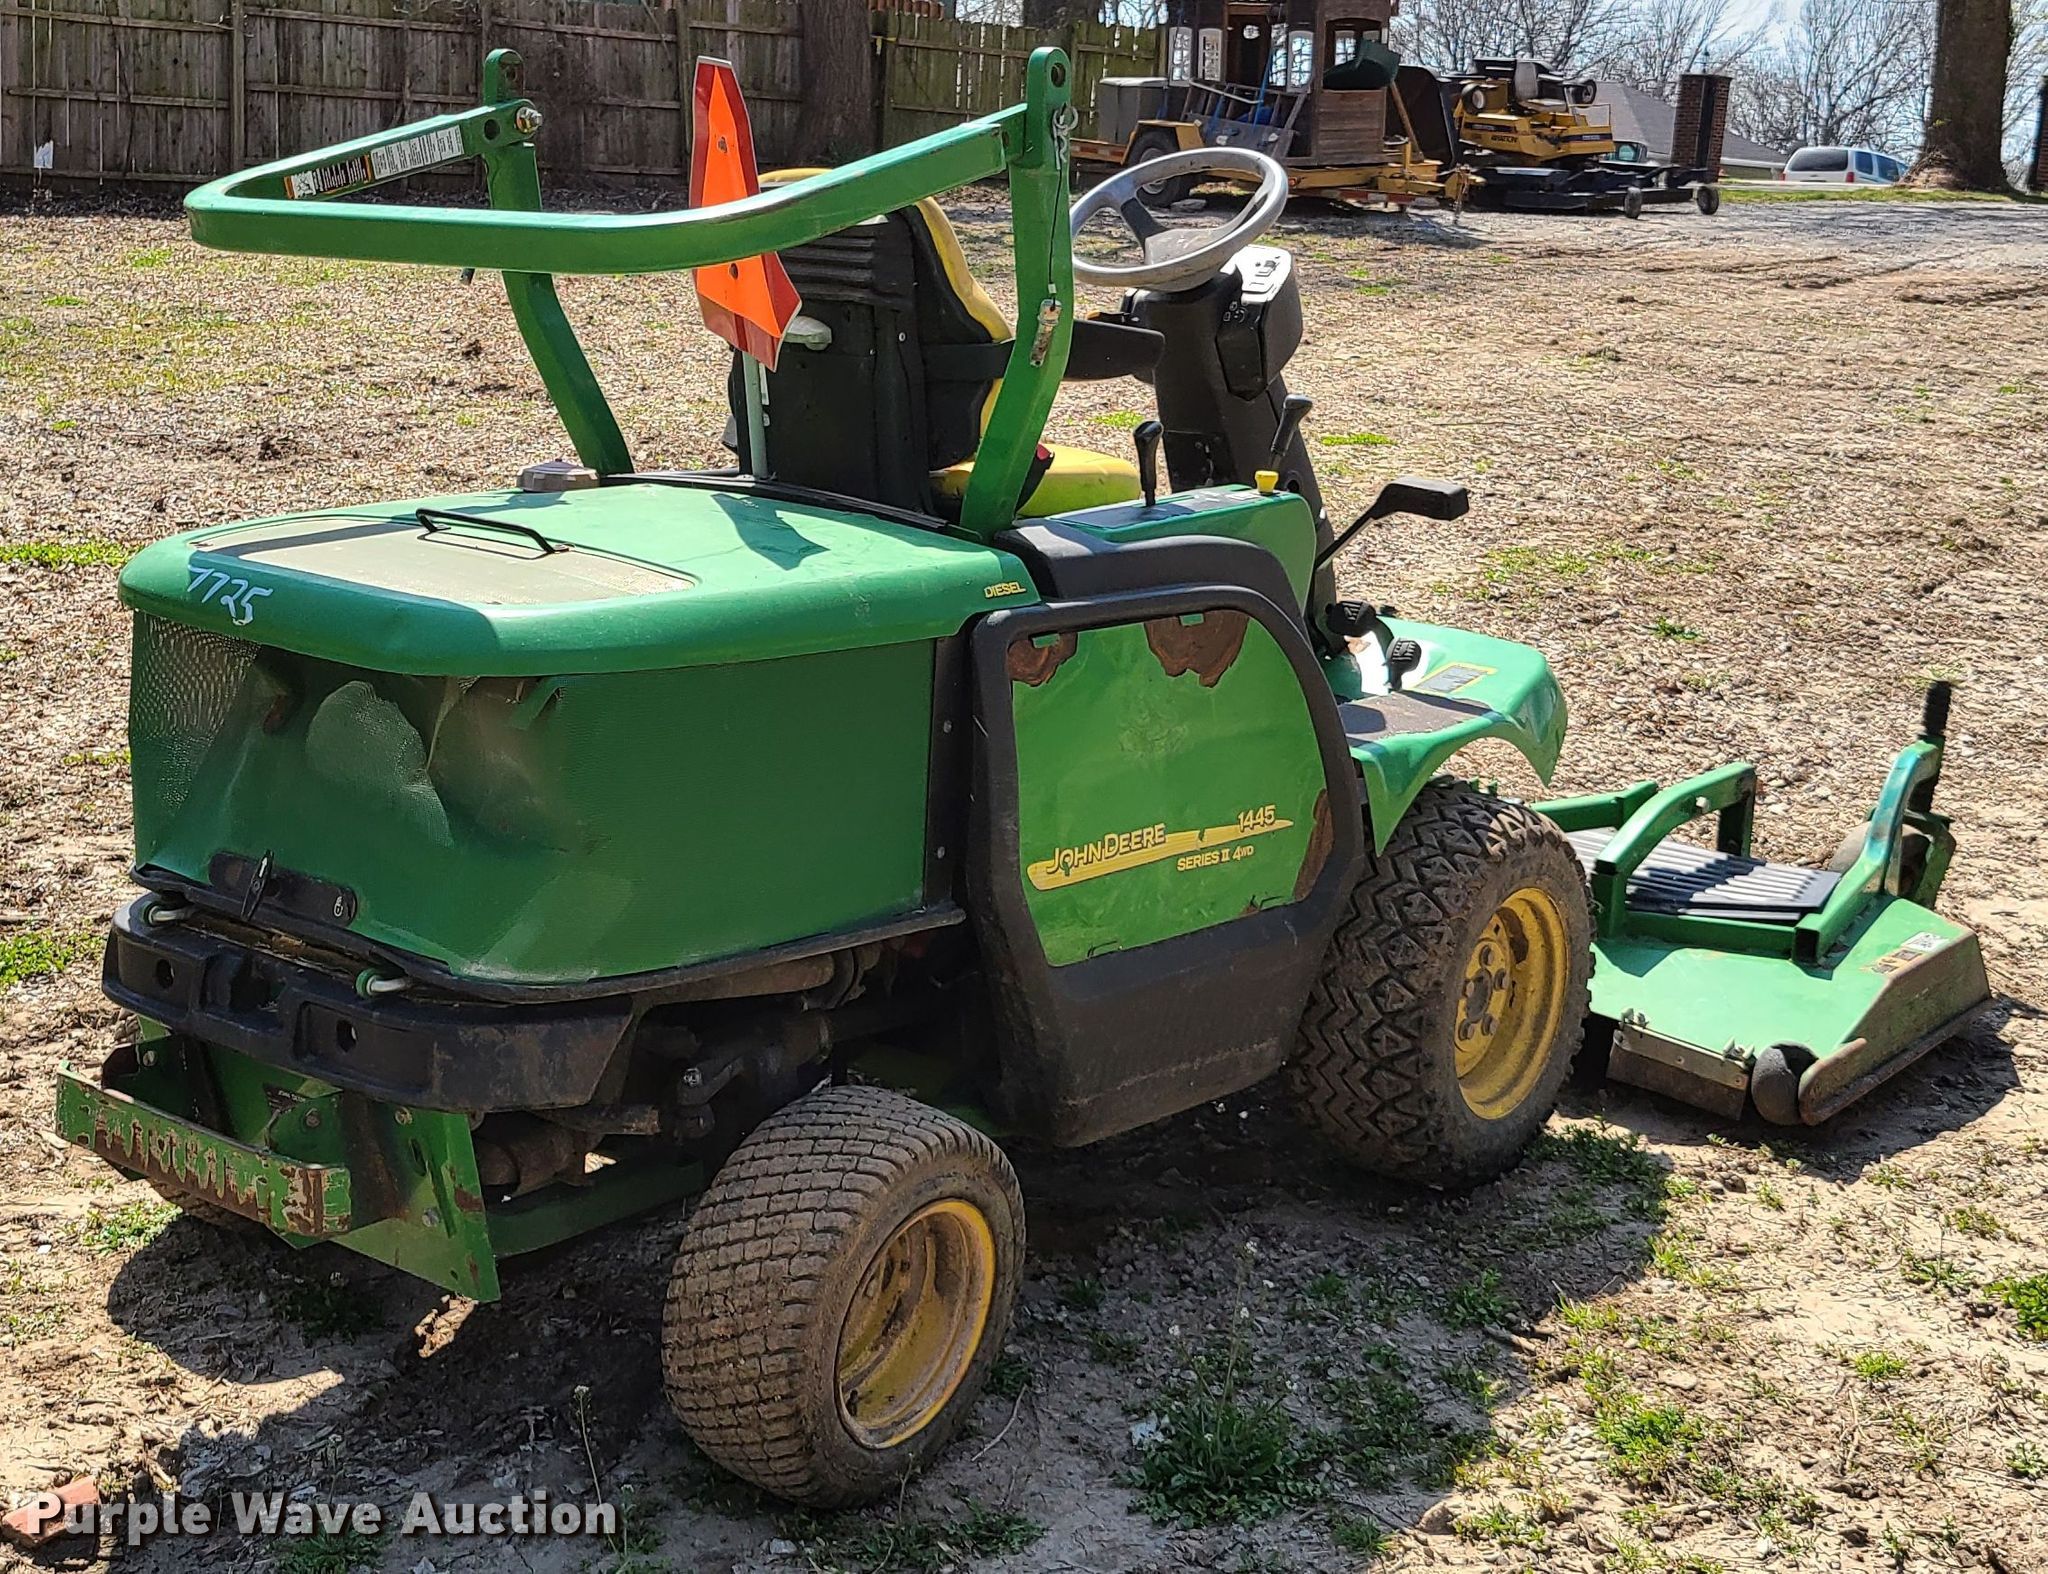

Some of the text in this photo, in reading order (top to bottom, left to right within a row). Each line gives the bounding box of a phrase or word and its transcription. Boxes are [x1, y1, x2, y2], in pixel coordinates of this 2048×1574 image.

[187, 564, 274, 626] 7725
[983, 581, 1027, 598] DIESEL
[1238, 804, 1276, 833] 1445
[1176, 848, 1221, 872] SERIES
[1232, 845, 1255, 862] 4WD
